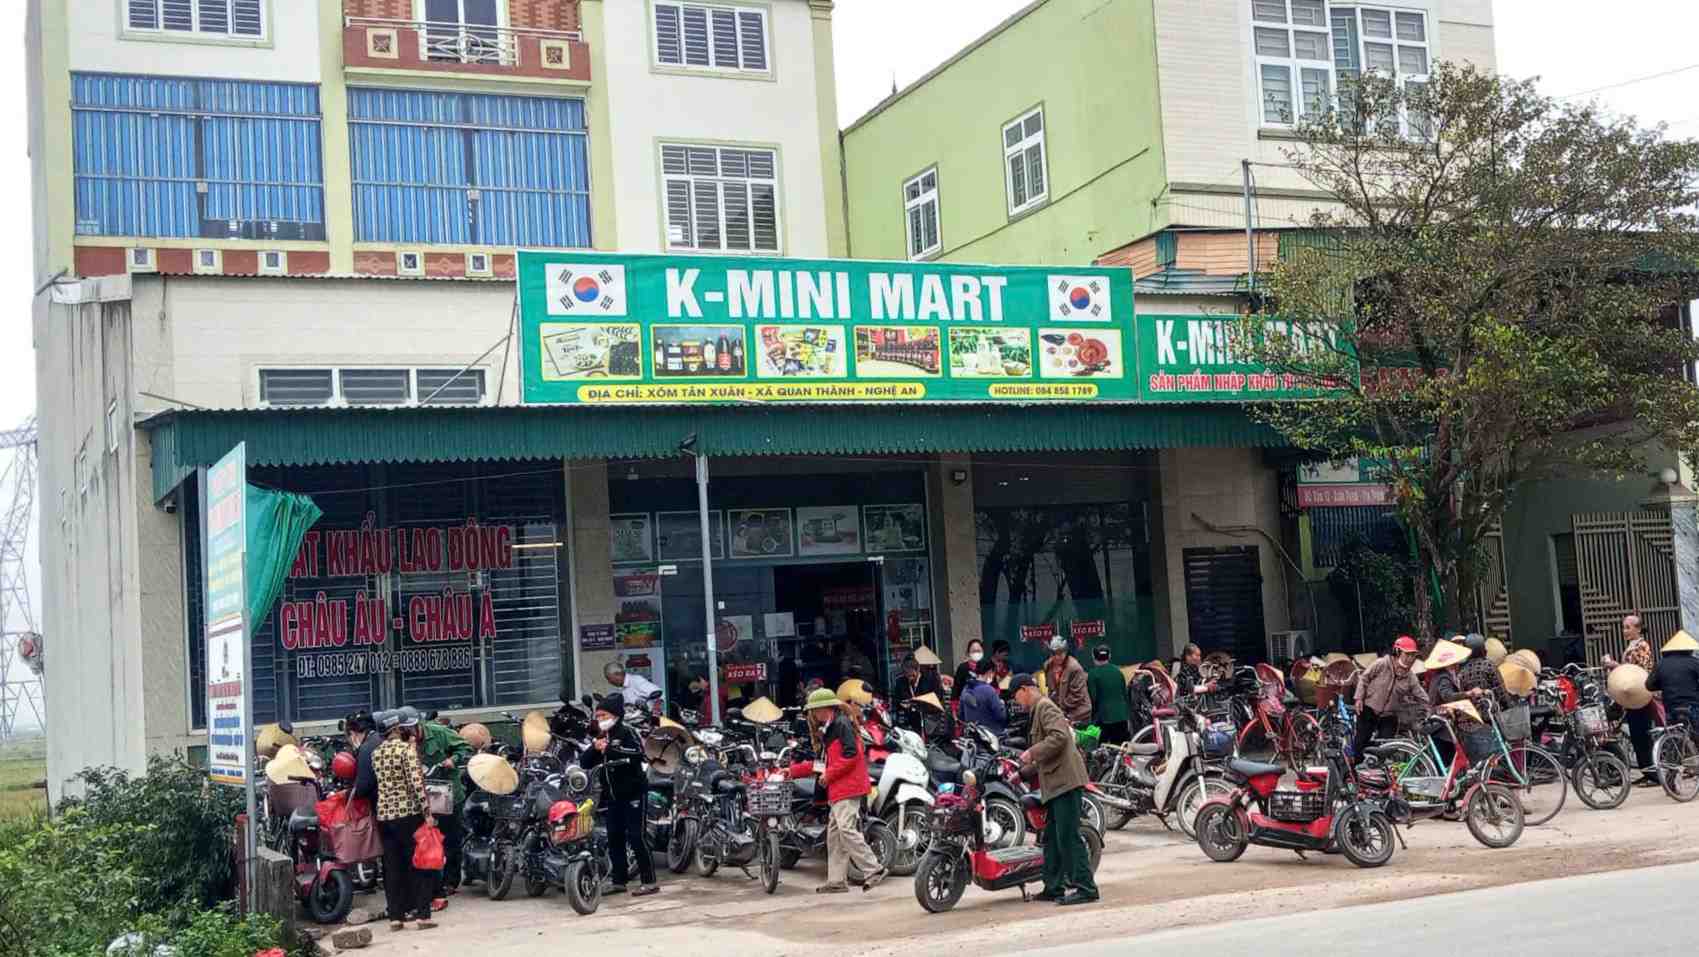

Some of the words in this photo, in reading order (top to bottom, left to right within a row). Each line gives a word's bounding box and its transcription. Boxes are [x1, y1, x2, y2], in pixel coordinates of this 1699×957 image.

[665, 267, 852, 319] K-MINI
[868, 272, 1008, 321] MART
[588, 389, 610, 401] ĐỊA
[647, 387, 678, 398] XÓM
[680, 386, 706, 398] TÂN
[710, 386, 745, 397] XUÂN
[776, 387, 812, 397] QUAN
[815, 385, 855, 396] THÀNH
[900, 386, 917, 395] AN
[993, 386, 1034, 396] HOTLINE:
[326, 511, 392, 576] KHẨU
[397, 527, 442, 573] LAO
[280, 590, 347, 650] CHÂU
[353, 590, 388, 646] ÂU
[408, 584, 473, 643] CHÂU
[479, 588, 497, 640] Á
[317, 654, 346, 677] 0985
[346, 652, 368, 675] 247
[369, 649, 392, 674] 012
[399, 649, 428, 673] 0888
[428, 648, 449, 670] 678
[451, 646, 471, 669] 886
